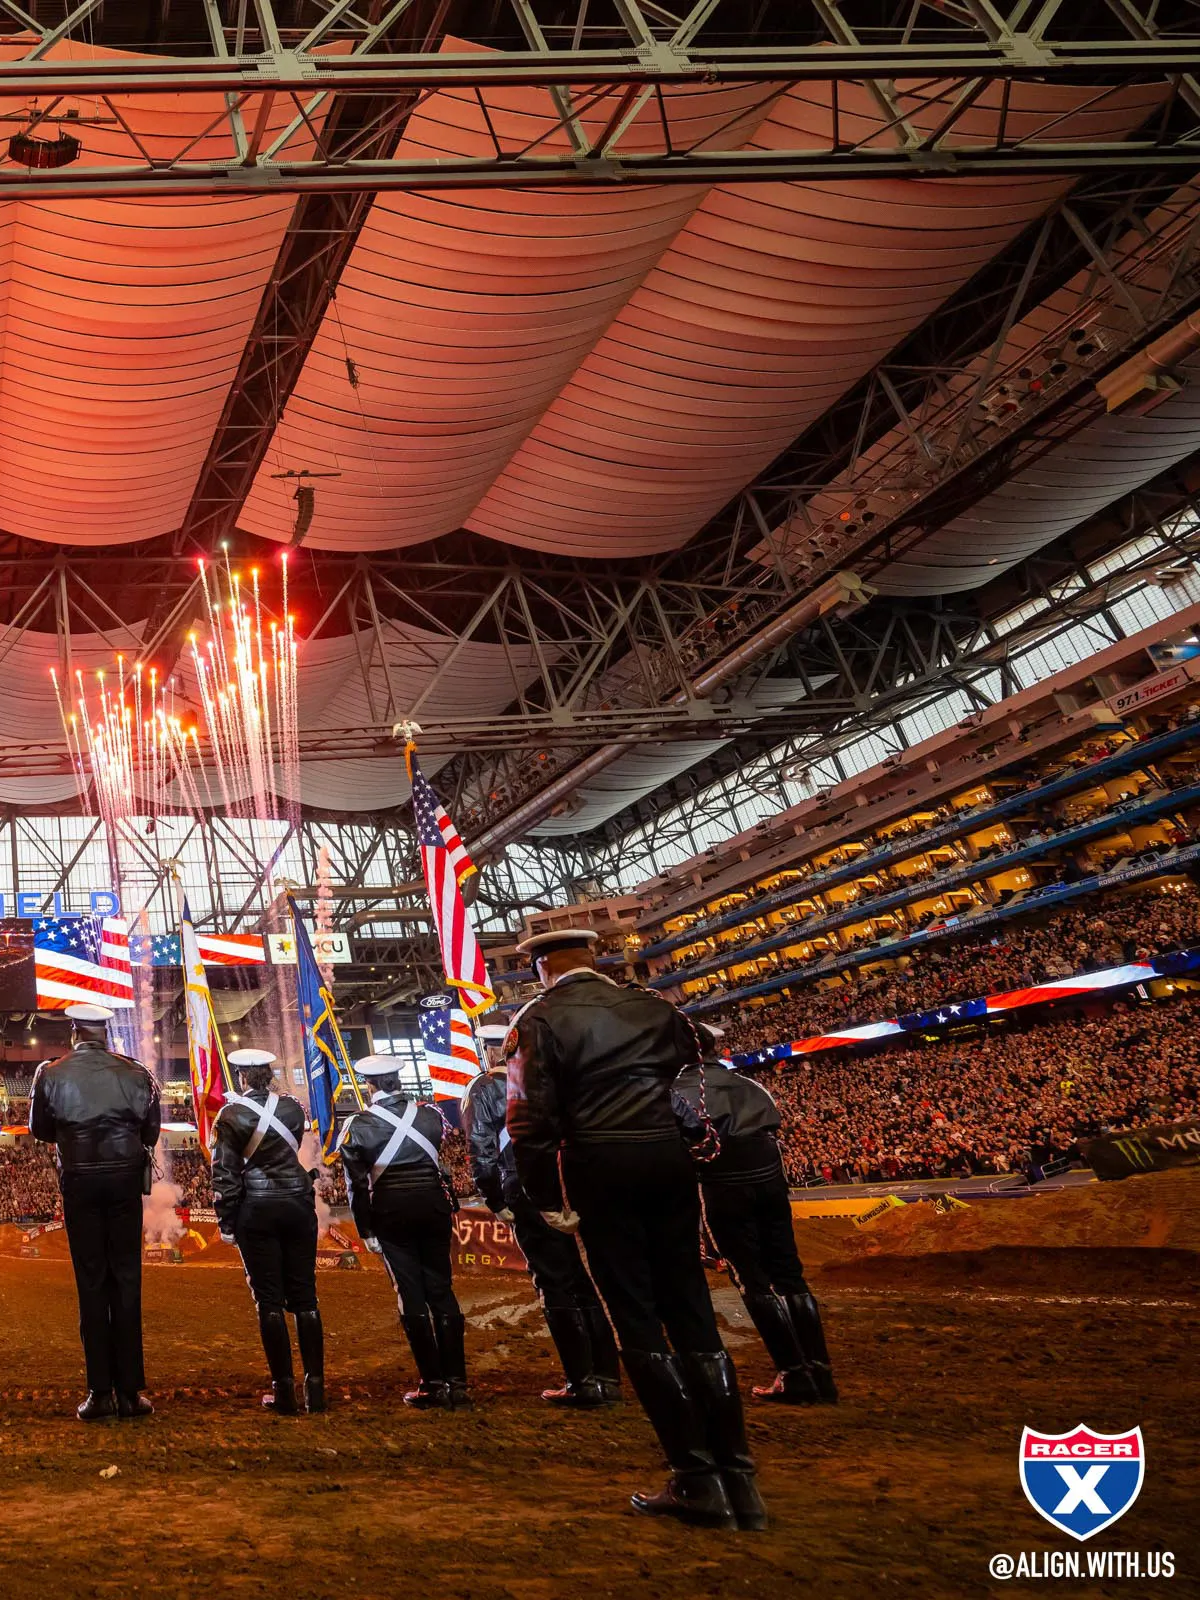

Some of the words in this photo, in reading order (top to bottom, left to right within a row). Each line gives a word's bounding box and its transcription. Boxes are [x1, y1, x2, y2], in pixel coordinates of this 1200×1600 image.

[1116, 691, 1139, 709] 97.1
[1143, 675, 1180, 697] TICKET
[1098, 874, 1125, 887] ROBERT
[1125, 863, 1159, 878] PORCHER
[855, 1200, 890, 1225] Kawasaki
